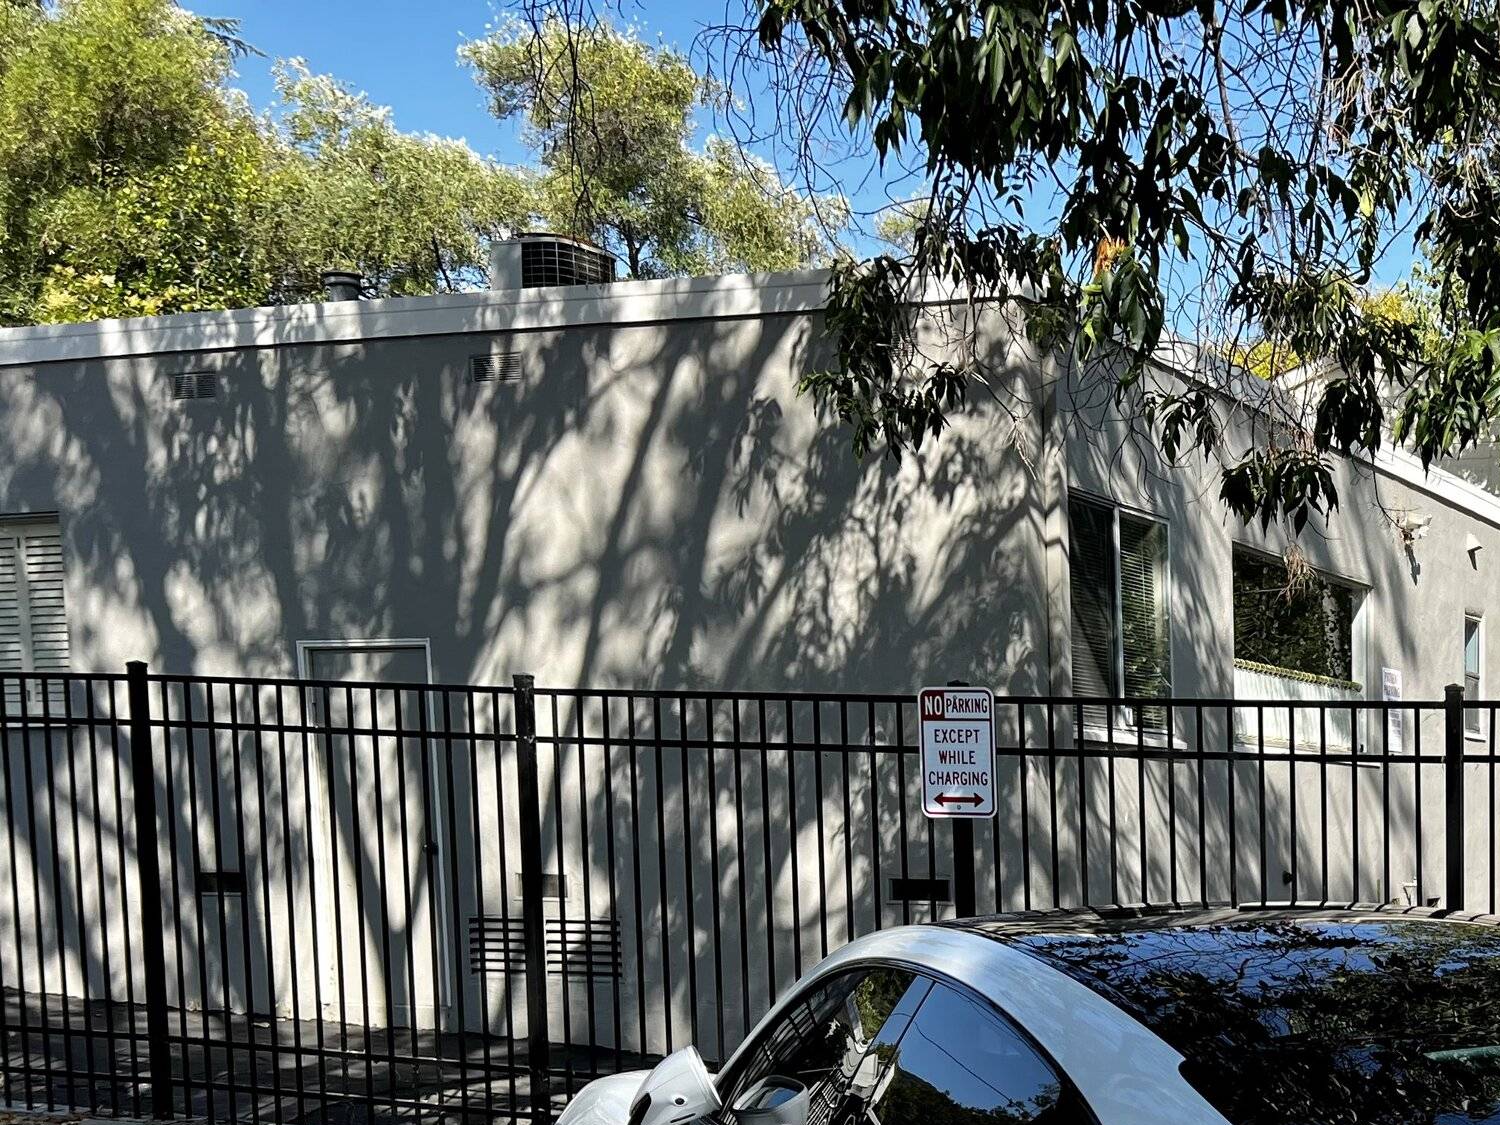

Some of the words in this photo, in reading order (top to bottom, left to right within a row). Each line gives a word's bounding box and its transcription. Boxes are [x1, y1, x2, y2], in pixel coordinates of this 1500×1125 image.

[924, 695, 943, 716] NO
[945, 698, 988, 714] PARKING
[934, 729, 980, 744] EXCEPT
[938, 750, 977, 765] WHILE
[928, 771, 989, 786] CHARGING
